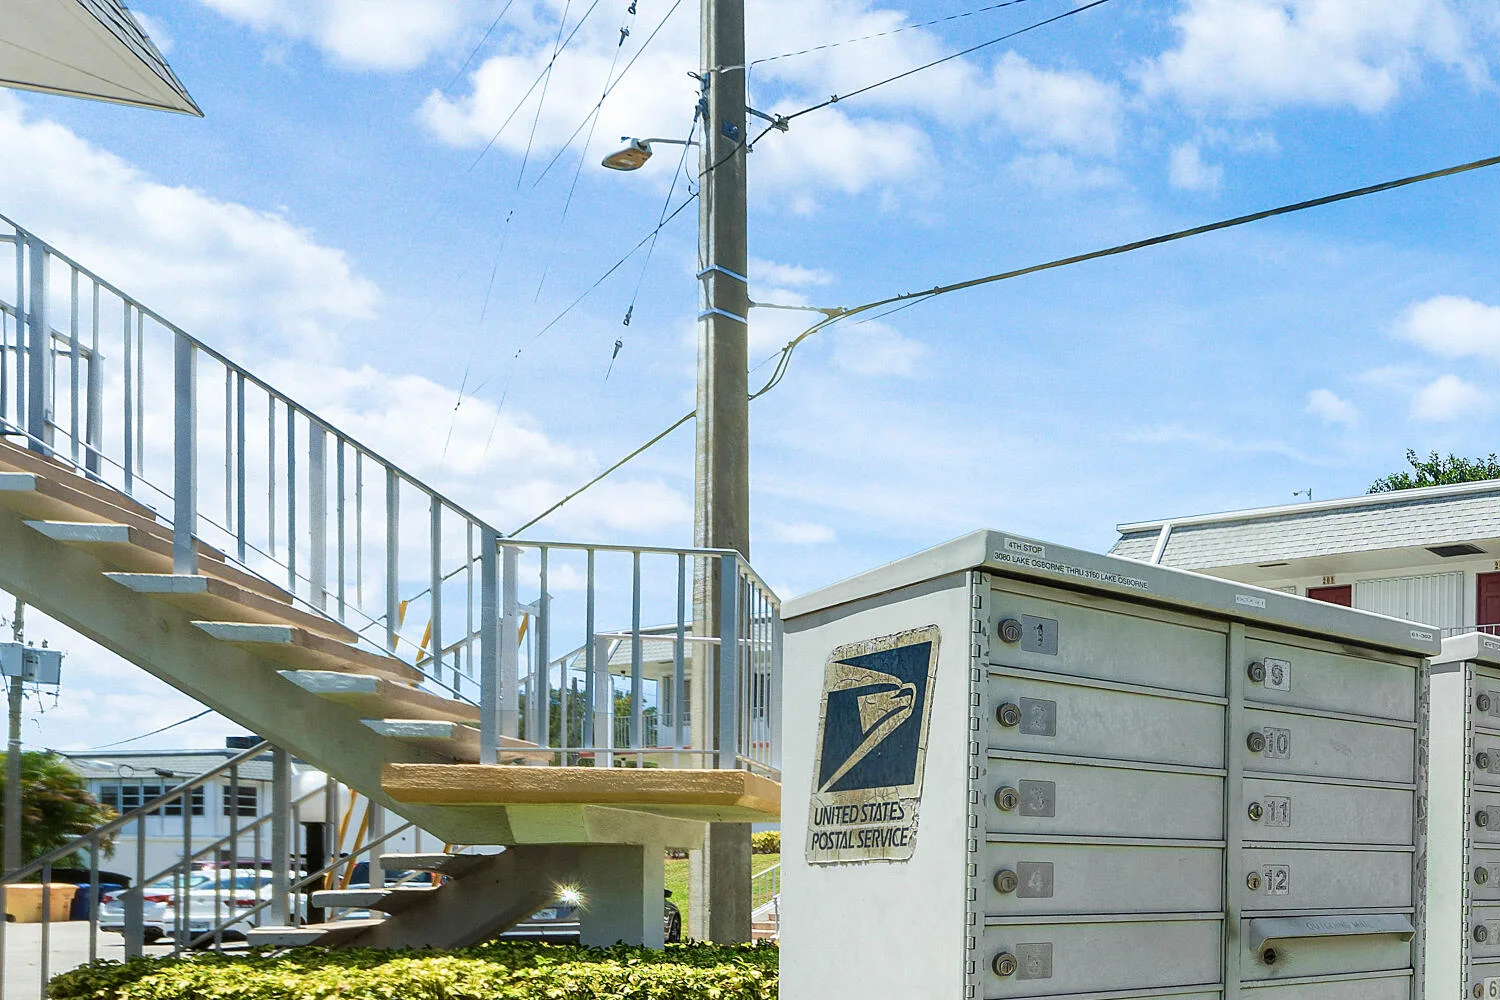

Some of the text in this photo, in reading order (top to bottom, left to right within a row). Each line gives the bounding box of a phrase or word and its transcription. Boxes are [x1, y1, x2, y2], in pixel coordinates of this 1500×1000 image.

[1008, 541, 1043, 554] 4TH STOP
[994, 552, 1011, 563] 3080
[1011, 555, 1031, 566] LAKE
[1031, 558, 1065, 573] OSBORNE
[1065, 565, 1084, 576] THRU
[1100, 571, 1117, 582] LAKE
[1117, 575, 1148, 589] OSBORNE
[1271, 664, 1284, 687] 9
[1031, 704, 1047, 730] 2
[1267, 732, 1288, 755] 10
[1031, 786, 1045, 811] 3
[814, 801, 905, 826] UNITED STATES
[1267, 800, 1288, 823] 11
[811, 827, 910, 851] POSTAL SERVICE
[1029, 869, 1044, 892] 4
[1264, 869, 1288, 892] 12
[1026, 953, 1040, 978] 5
[1489, 980, 1498, 997] 6
